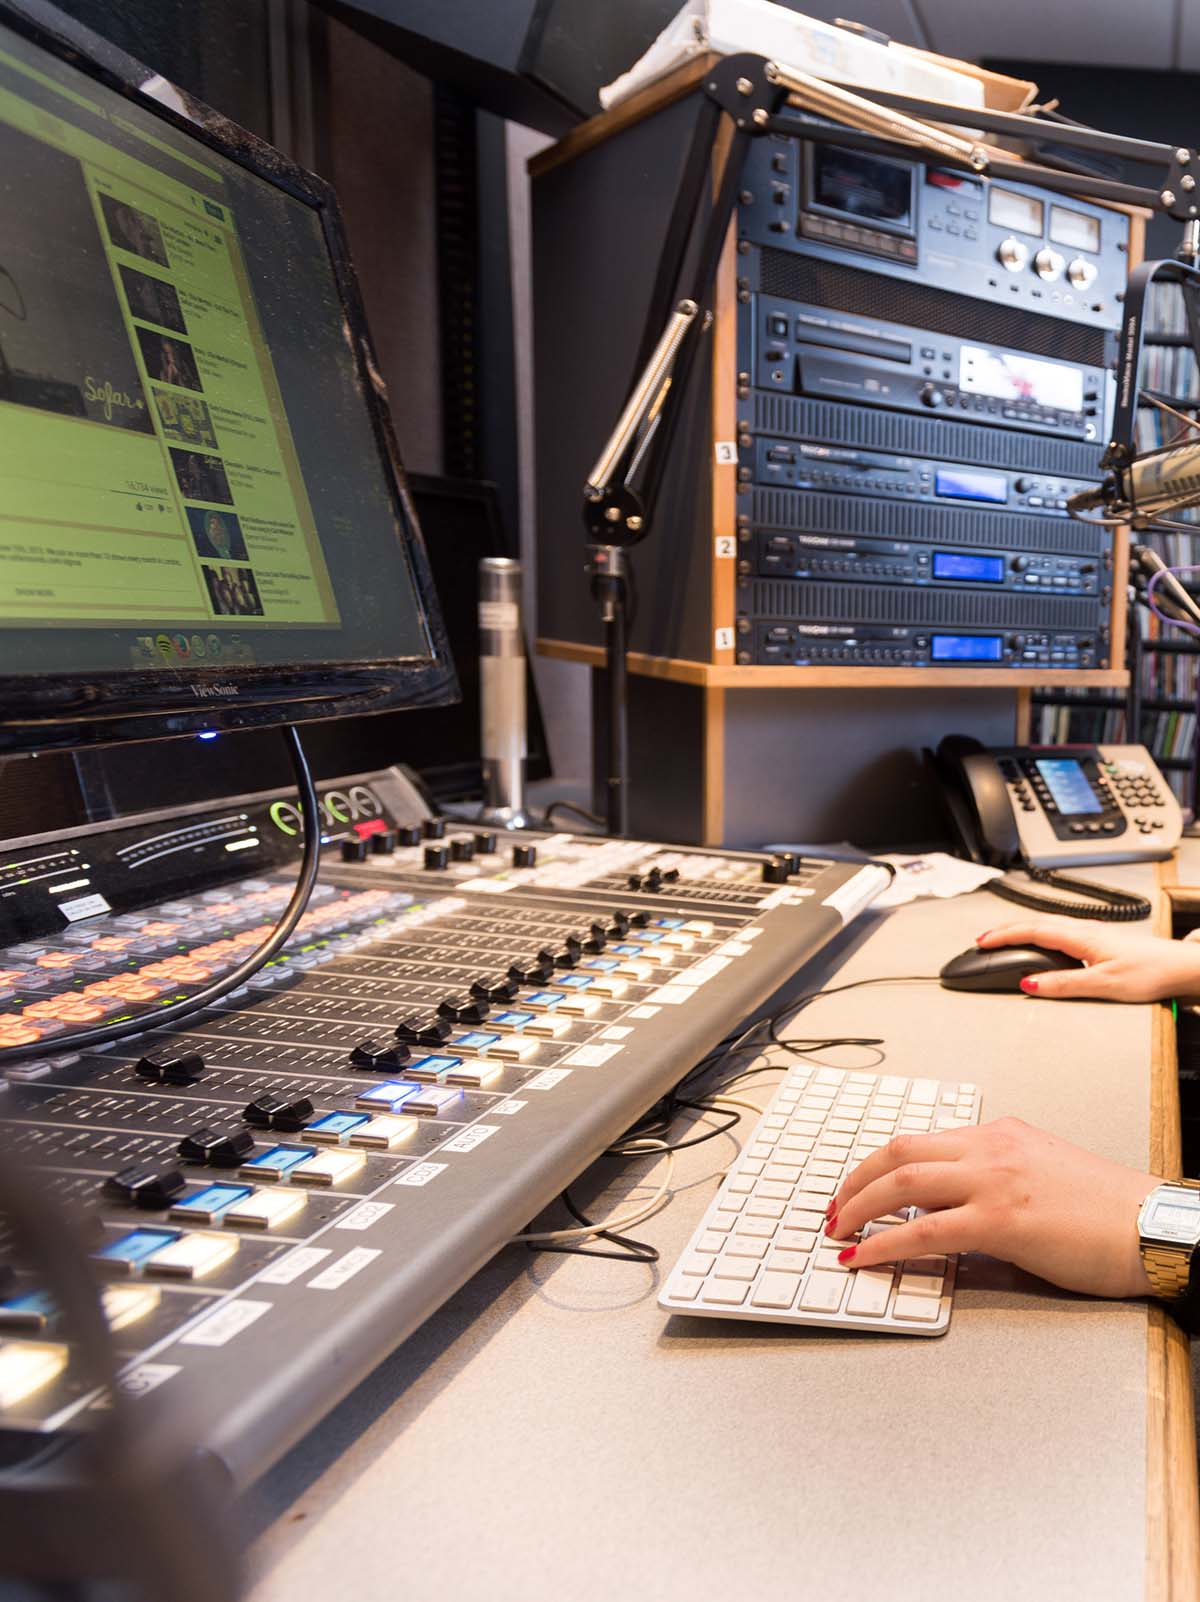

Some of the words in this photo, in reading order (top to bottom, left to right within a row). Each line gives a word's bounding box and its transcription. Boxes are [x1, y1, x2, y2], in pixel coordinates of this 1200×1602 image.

[720, 445, 732, 460] 3
[721, 540, 731, 554] 2
[190, 682, 240, 698] ViewSonic
[453, 1127, 489, 1148] AUTO
[407, 1165, 440, 1183] CD3
[349, 1205, 384, 1226] CD2
